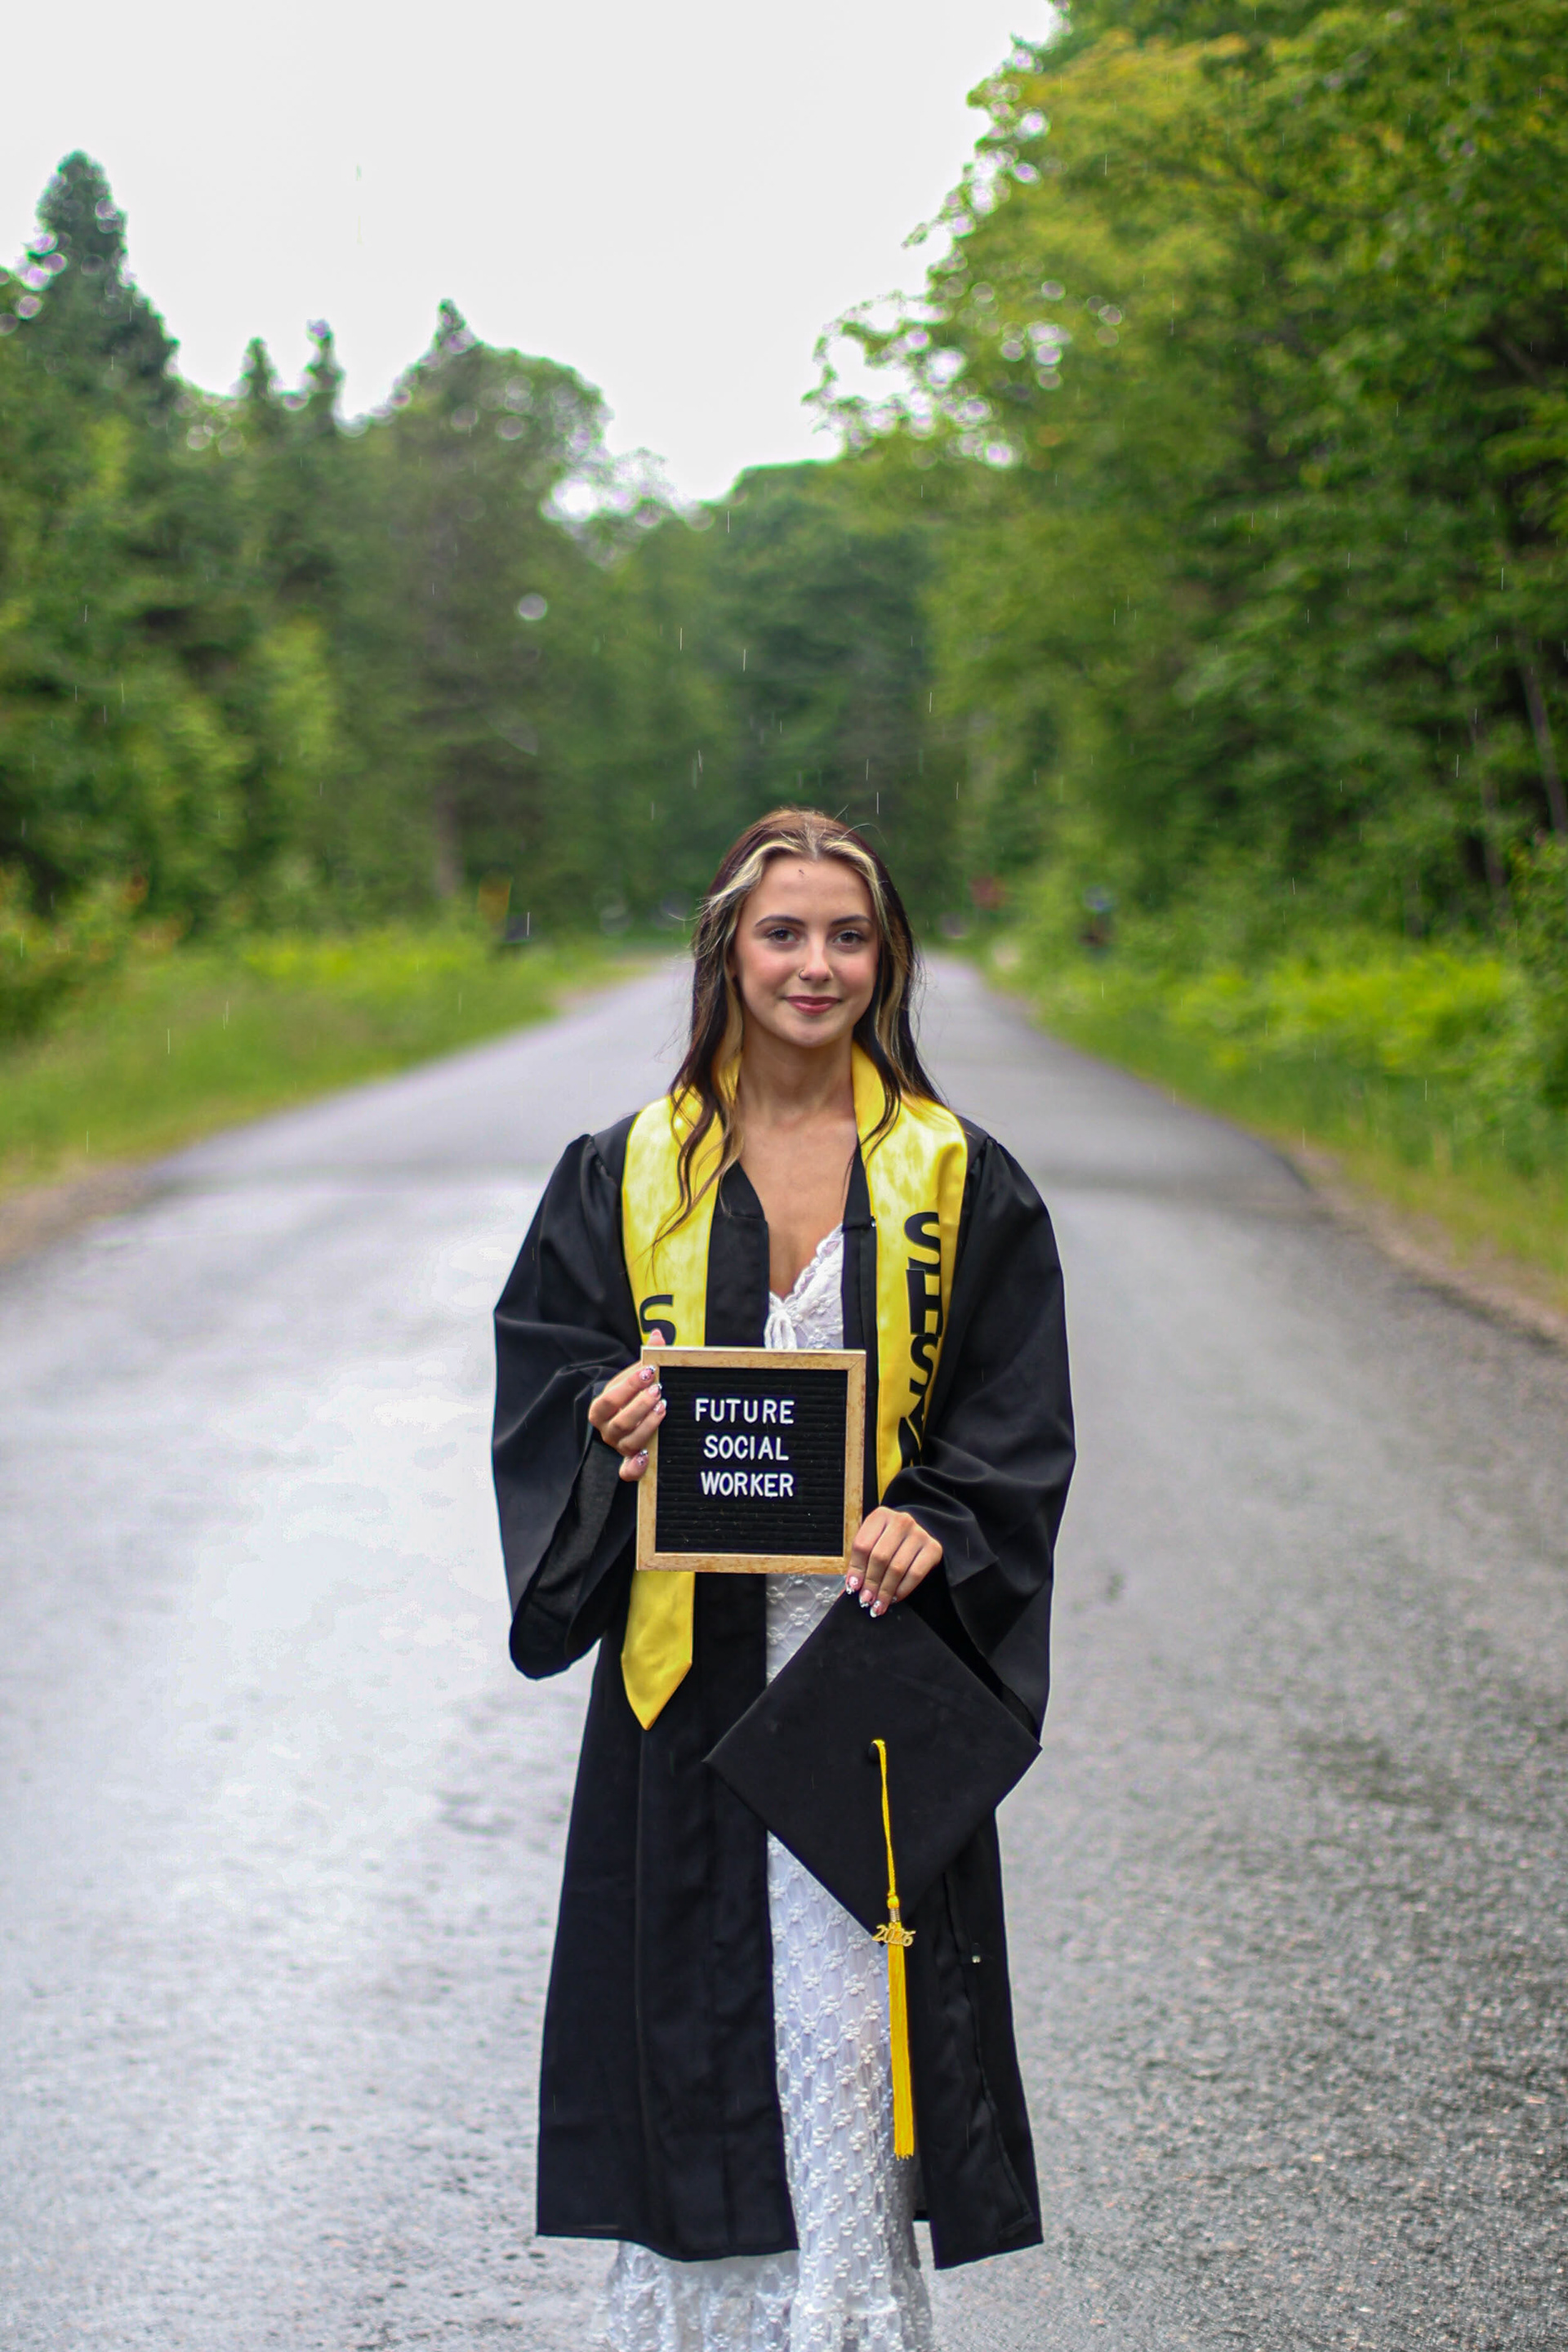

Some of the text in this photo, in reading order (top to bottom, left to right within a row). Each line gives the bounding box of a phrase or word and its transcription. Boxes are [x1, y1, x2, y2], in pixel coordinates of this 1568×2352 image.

[695, 1397, 795, 1424] FUTURE
[703, 1435, 790, 1461] SOCIAL
[700, 1471, 795, 1497] WORKER
